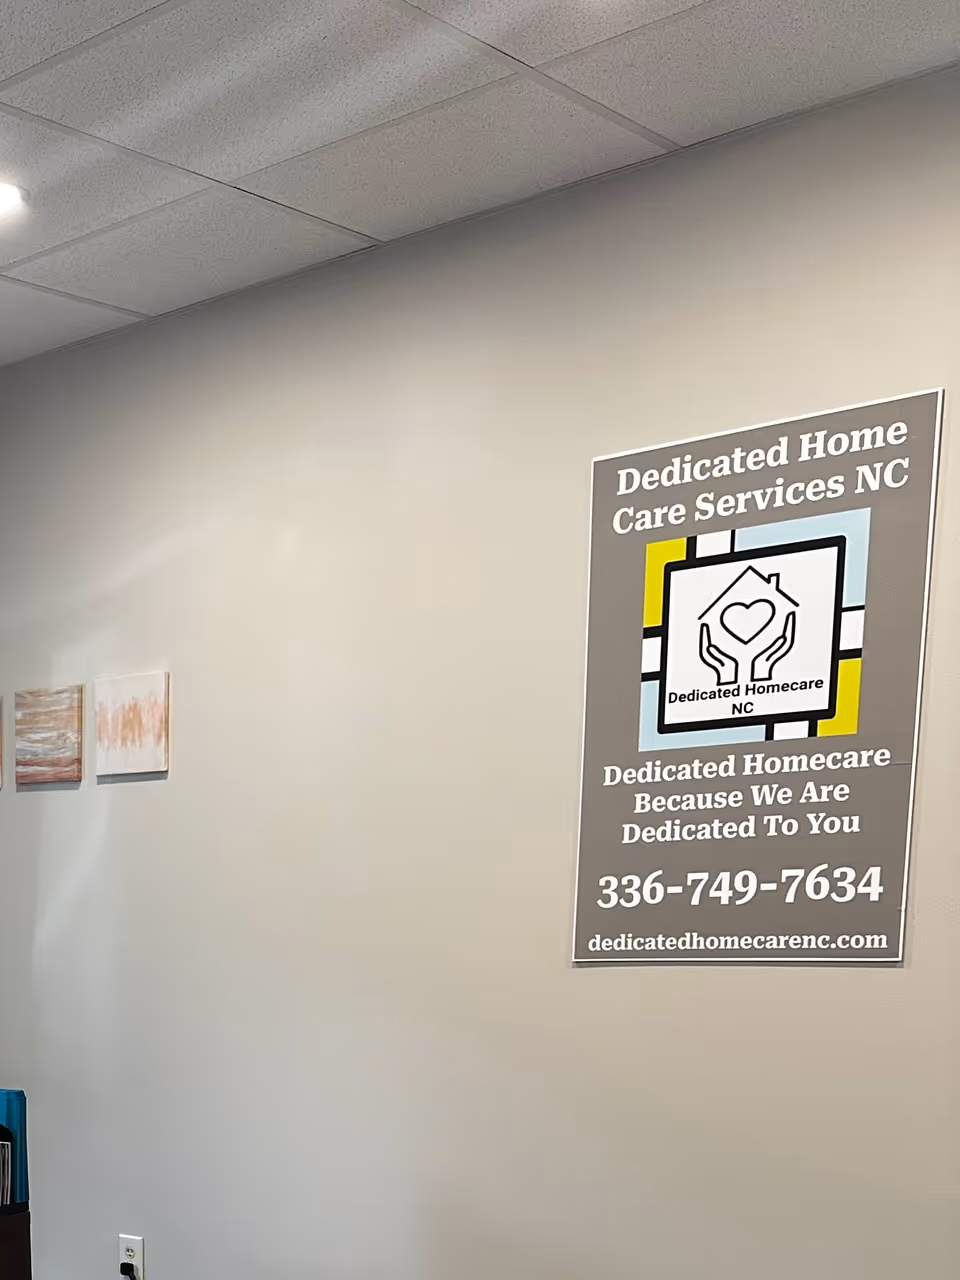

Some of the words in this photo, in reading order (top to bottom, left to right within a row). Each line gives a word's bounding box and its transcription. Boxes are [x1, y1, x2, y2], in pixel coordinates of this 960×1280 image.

[616, 436, 788, 496] Dedicated
[797, 420, 908, 463] Home
[612, 504, 686, 535] Care
[694, 475, 845, 522] Services
[854, 457, 910, 494] NC
[668, 685, 741, 704] Dedicated
[744, 678, 824, 697] Homecare
[731, 701, 755, 715] NC
[603, 755, 735, 786] Dedicated
[742, 748, 891, 776] Homecare
[633, 790, 743, 814] Because
[750, 784, 793, 807] We
[799, 782, 850, 804] Are
[621, 815, 756, 844] Dedicated
[763, 814, 799, 837] To
[806, 811, 861, 836] You
[596, 863, 884, 909] 336-749-7634
[588, 931, 888, 952] dedicatedhomecarenc.com
